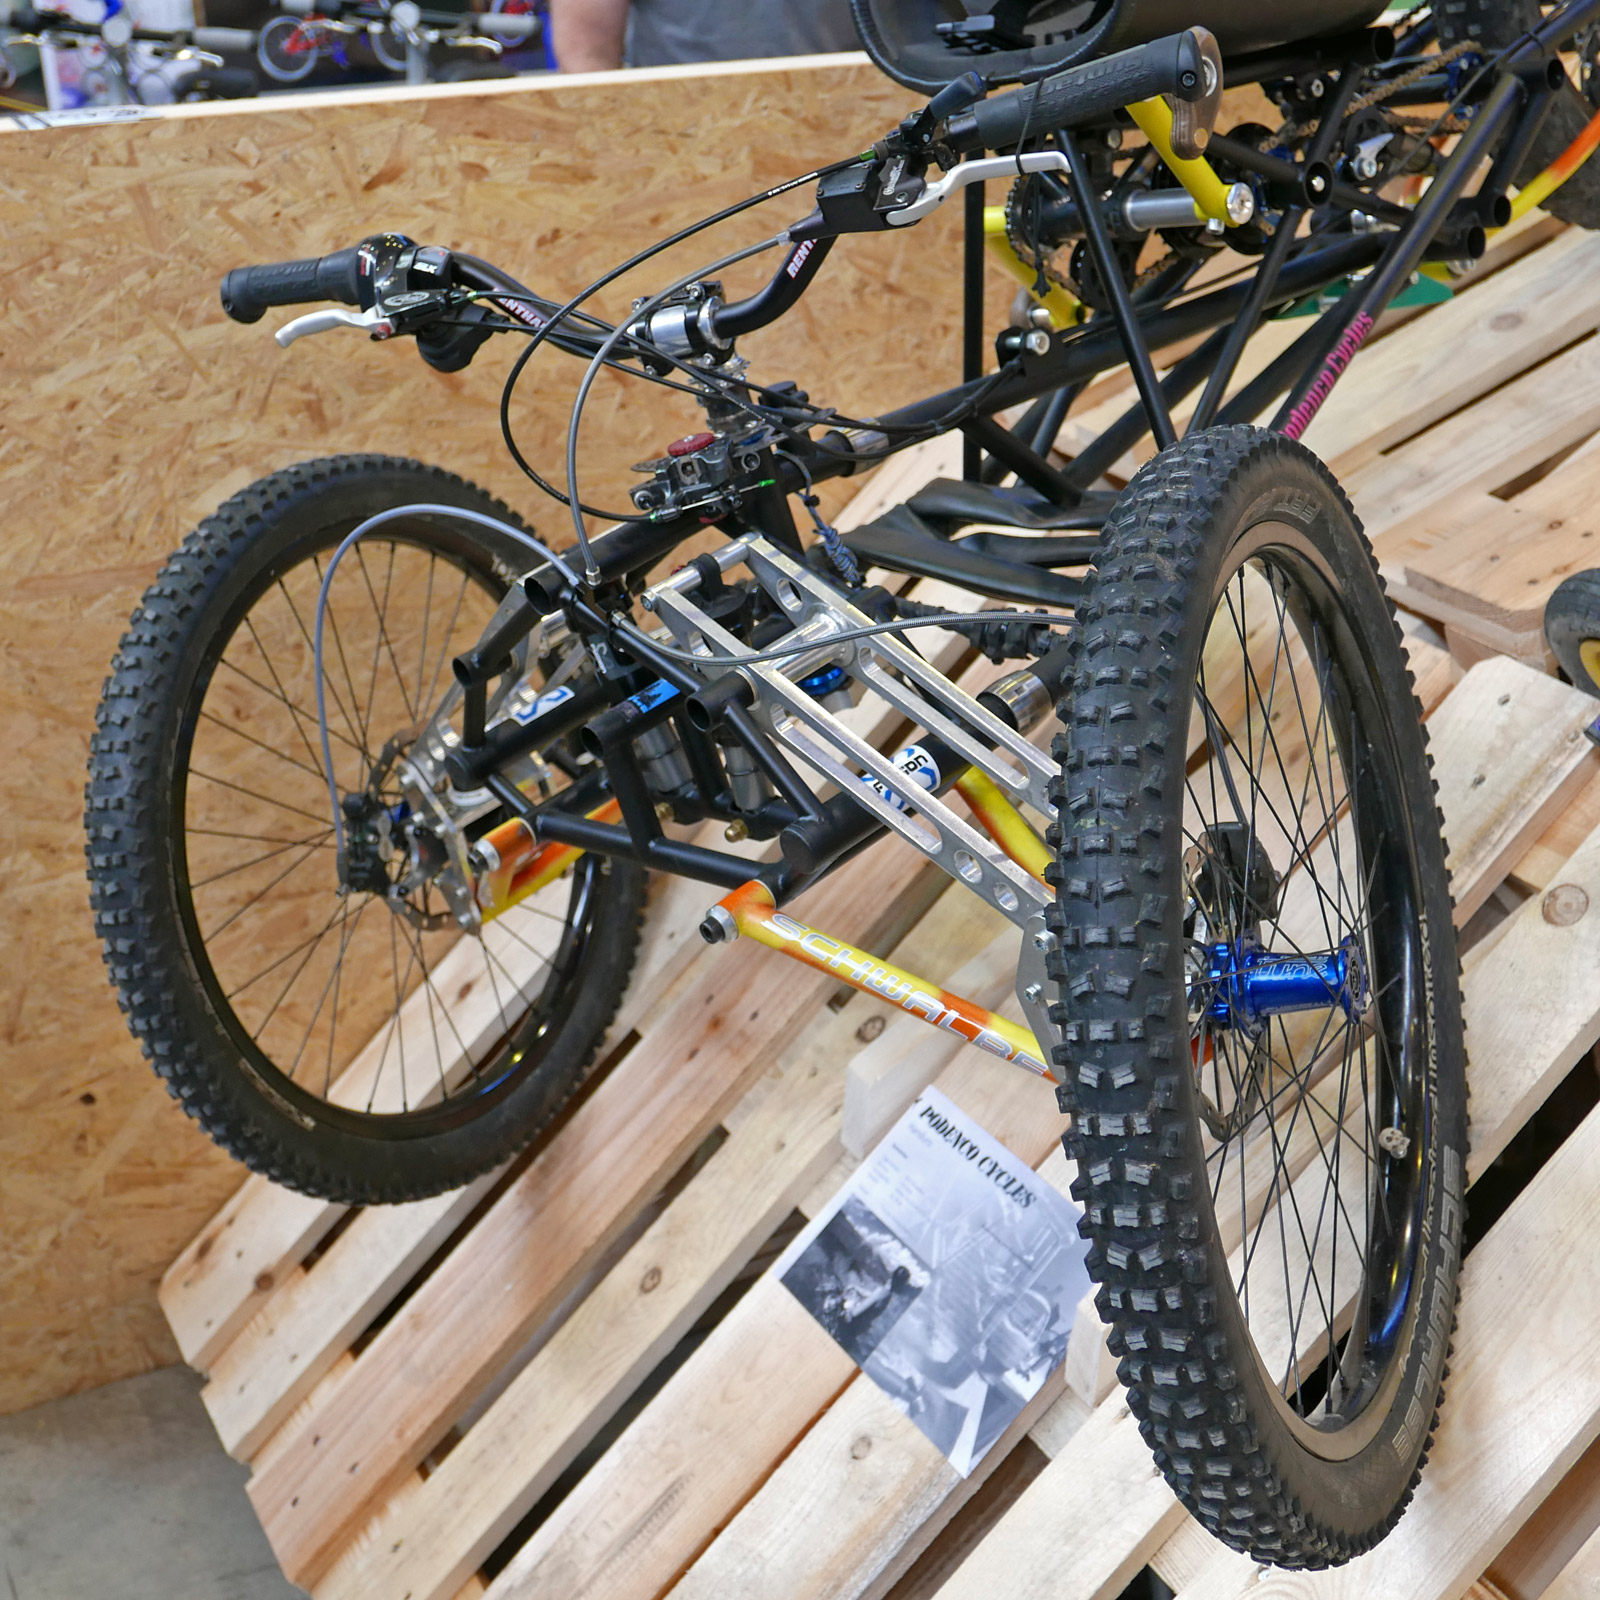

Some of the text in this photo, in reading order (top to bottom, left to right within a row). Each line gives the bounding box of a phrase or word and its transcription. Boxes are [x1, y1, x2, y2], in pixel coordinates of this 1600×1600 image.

[786, 238, 818, 280] RENT
[1278, 311, 1374, 440] odenco Cycles
[760, 913, 1050, 1077] SCHWALBE
[977, 1156, 1037, 1209] CYCLES
[1391, 1144, 1462, 1466] SCHWALBE
